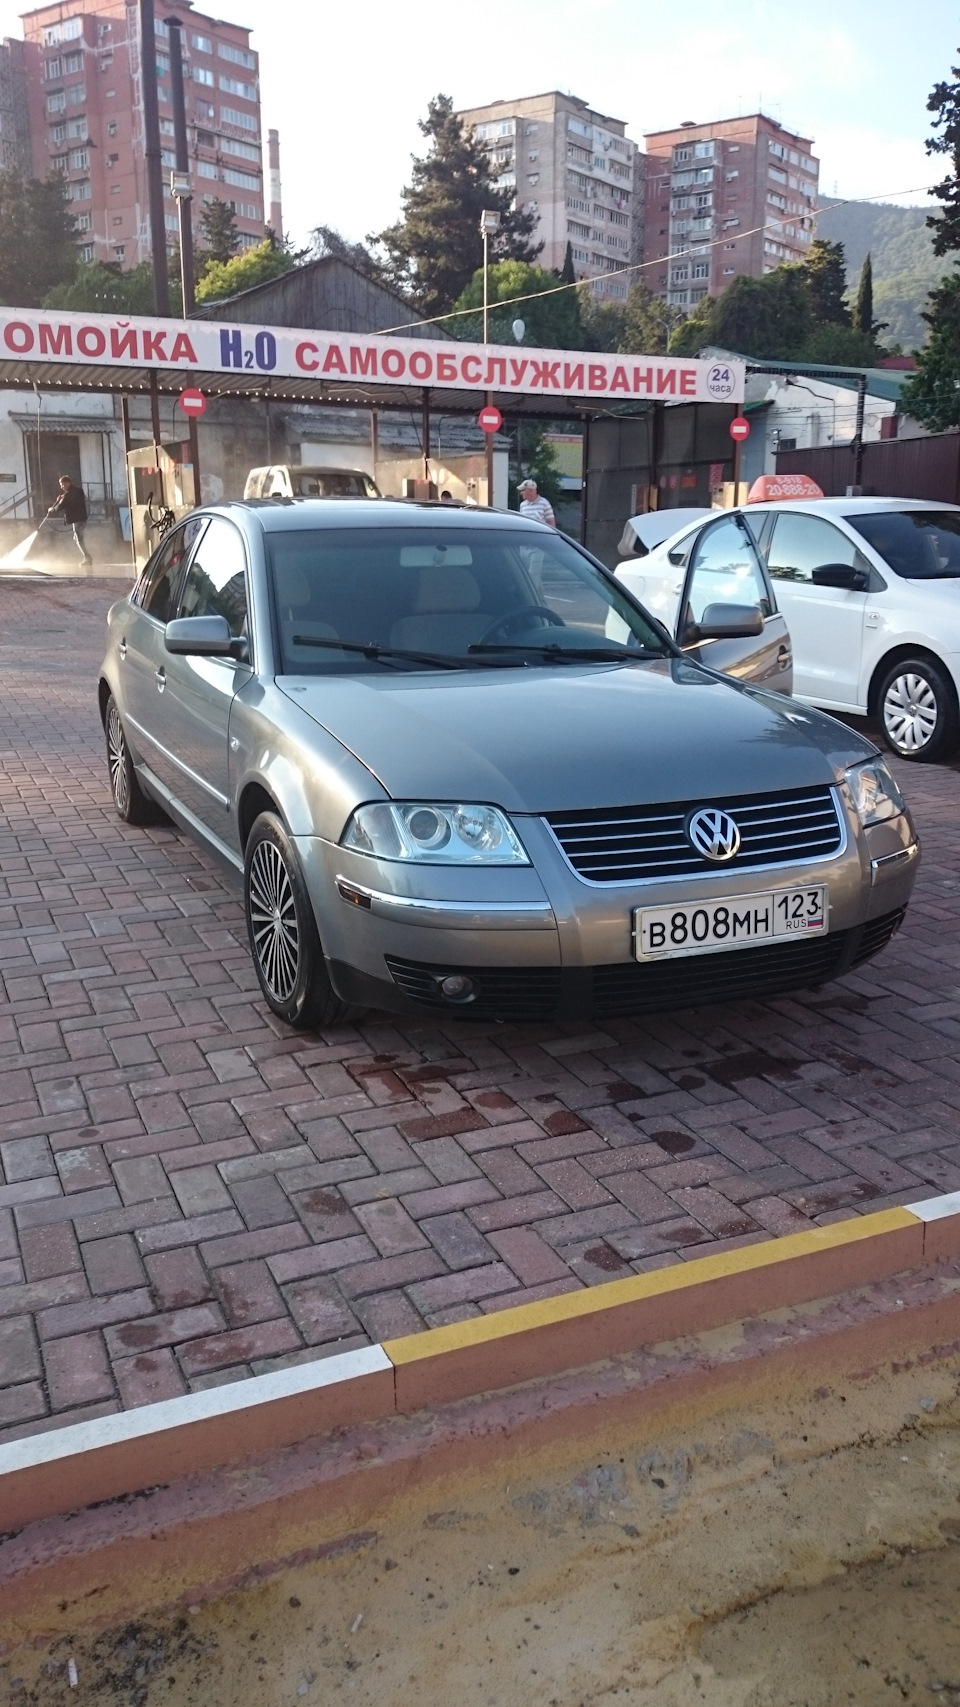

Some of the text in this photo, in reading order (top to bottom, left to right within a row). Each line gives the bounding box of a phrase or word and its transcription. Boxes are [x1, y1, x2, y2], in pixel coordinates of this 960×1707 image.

[3, 321, 198, 364] ОМОЙКА
[295, 341, 698, 396] САМООБСЛУЖИВАНИЕ
[712, 368, 730, 382] 24
[710, 384, 731, 393] часа
[766, 483, 820, 496] 20-888-20
[650, 891, 820, 948] В808МН 123
[786, 917, 807, 930] RUS
